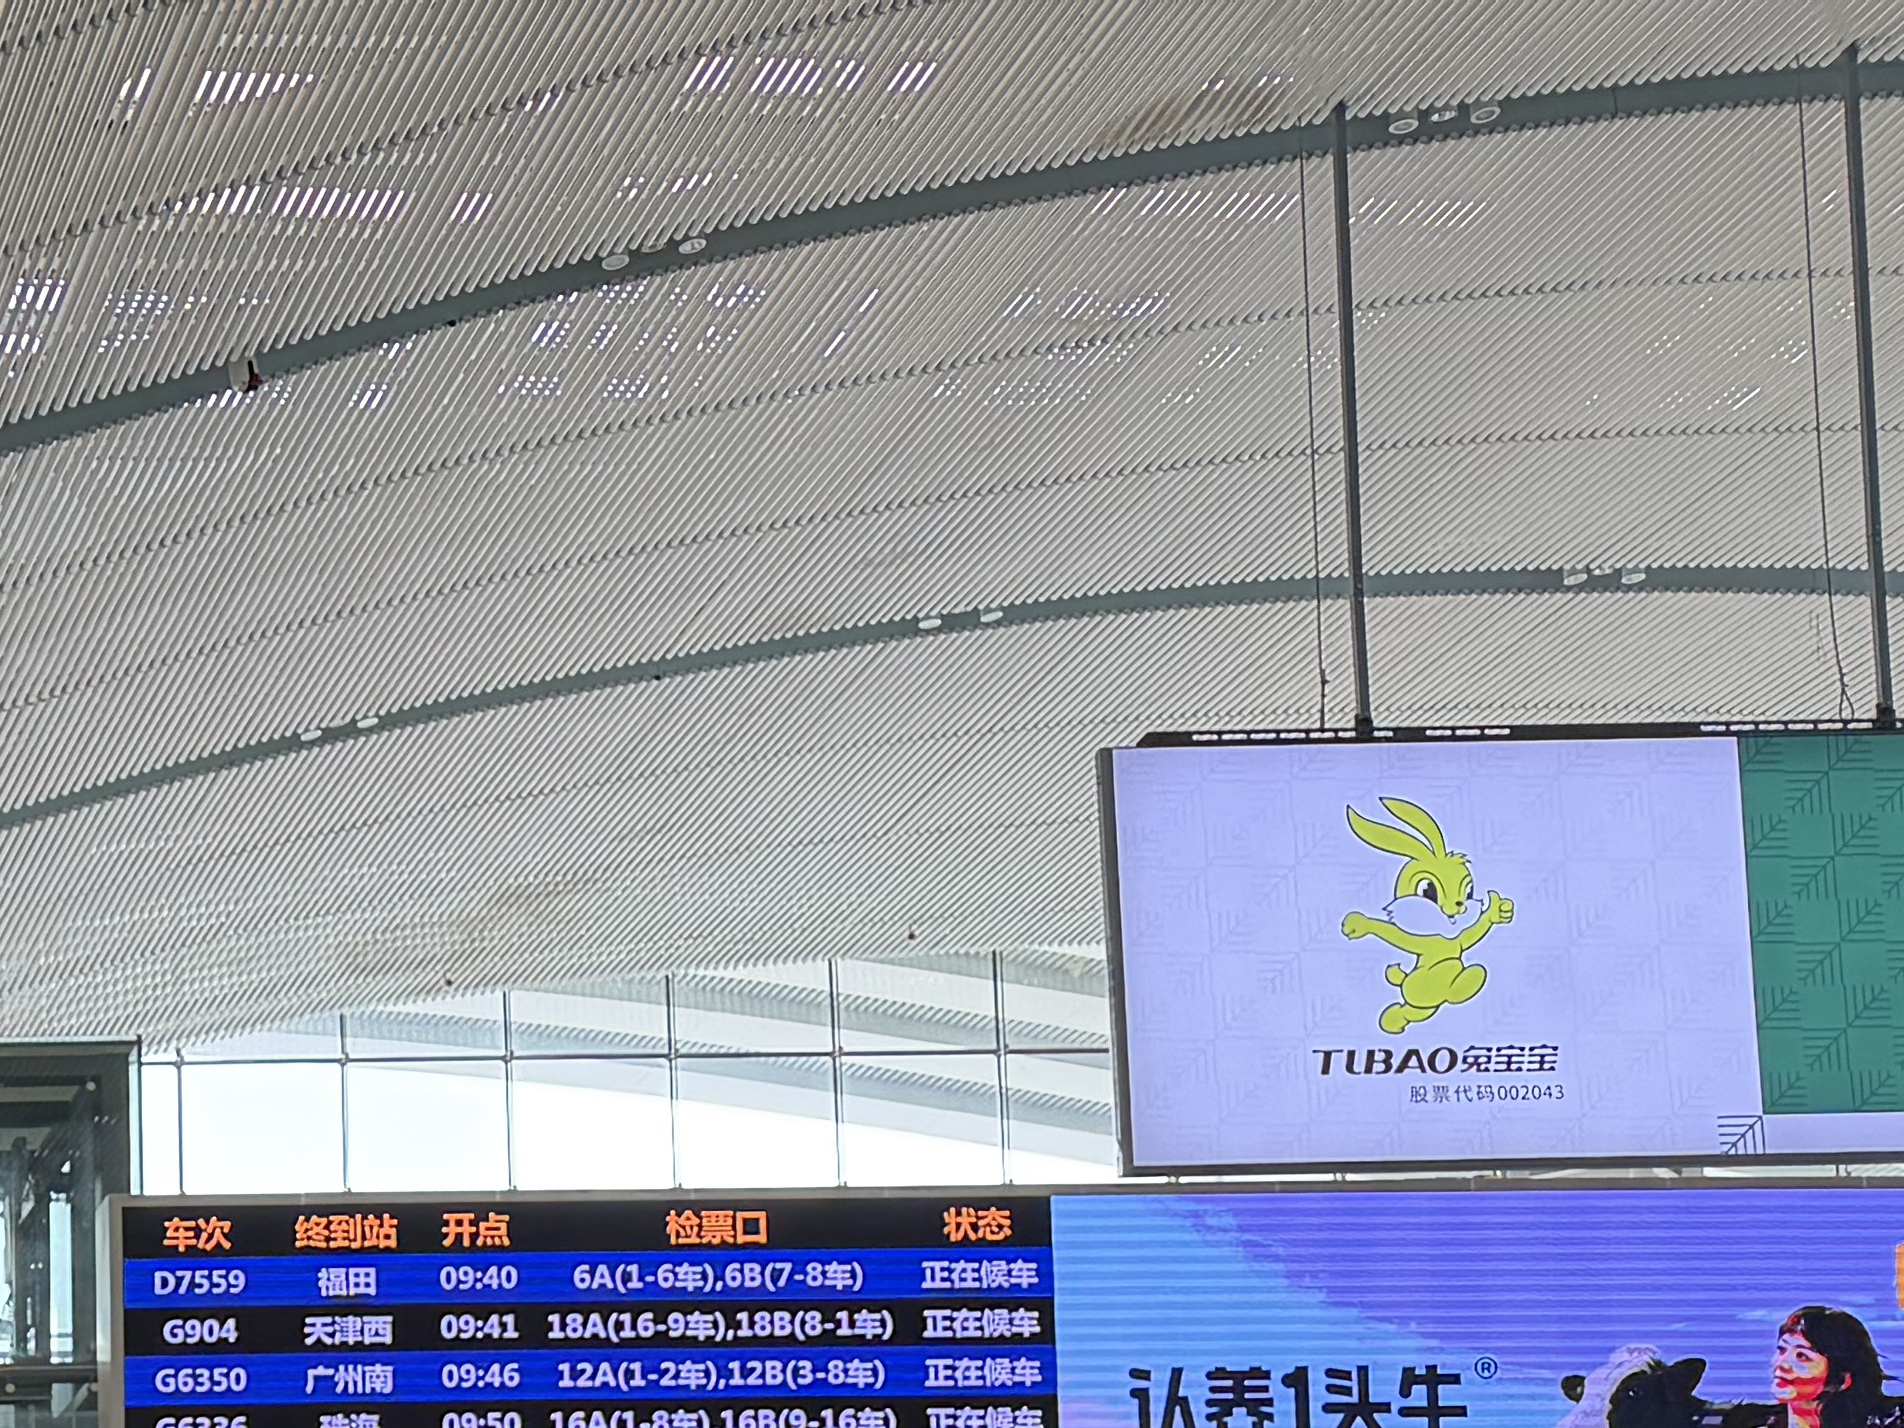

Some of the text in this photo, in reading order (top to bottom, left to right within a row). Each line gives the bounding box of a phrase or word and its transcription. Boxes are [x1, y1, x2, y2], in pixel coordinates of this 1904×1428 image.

[1408, 1084, 1566, 1104] 股票代码002043
[162, 1206, 1013, 1253] 车次 终到站 开点 检票口 状态
[154, 1269, 246, 1295] D7559
[317, 1267, 377, 1297] 福田
[439, 1265, 518, 1291] 09:40
[921, 1259, 1039, 1289] 正在候车
[163, 1317, 238, 1344] G904
[303, 1315, 393, 1346] 天津西
[440, 1313, 519, 1339] 09:41
[922, 1307, 1041, 1339] 正在候车
[155, 1367, 247, 1393] G6350
[305, 1363, 394, 1394] 广州南
[442, 1362, 520, 1388] 09:46
[924, 1357, 1042, 1387] 正在候车
